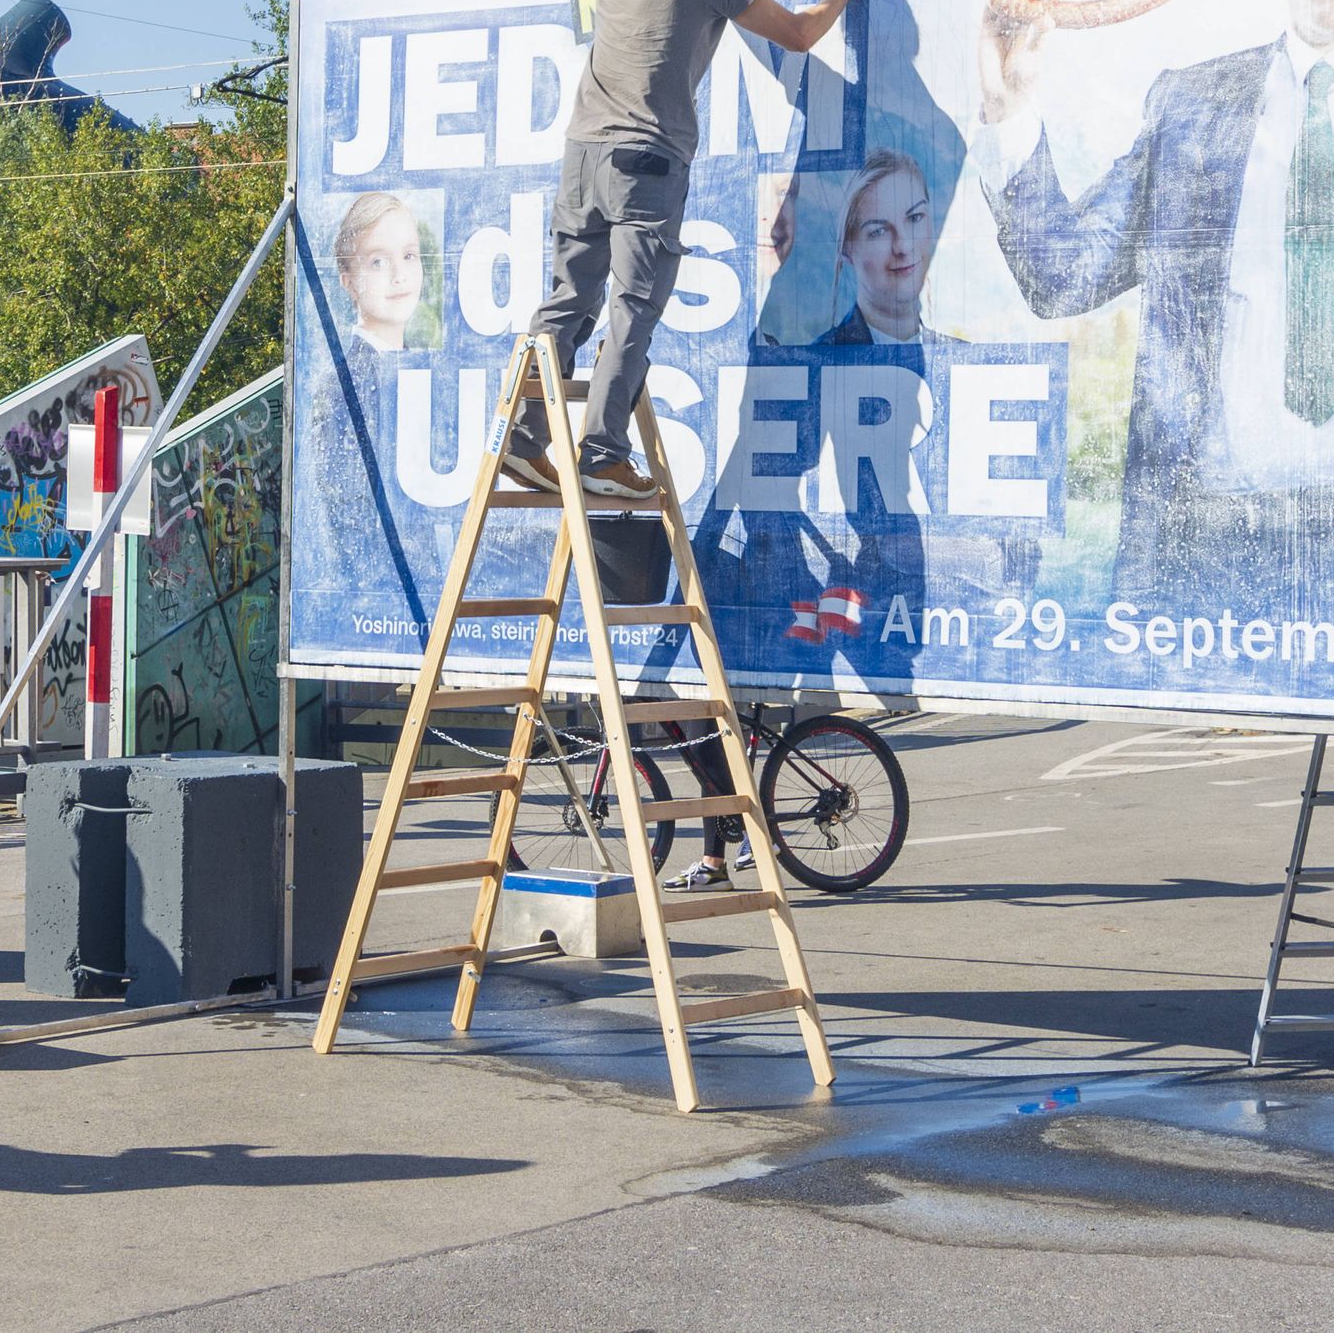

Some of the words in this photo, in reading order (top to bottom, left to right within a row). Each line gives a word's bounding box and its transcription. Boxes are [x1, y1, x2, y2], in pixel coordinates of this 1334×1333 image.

[331, 2, 848, 176] JEDM
[458, 192, 742, 337] ds
[396, 363, 1049, 518] USERE
[491, 419, 507, 453] KRAUSE
[352, 614, 433, 636] Yoshinori
[451, 623, 487, 643] wa,
[878, 593, 969, 648] Am
[991, 597, 1082, 652] 29.
